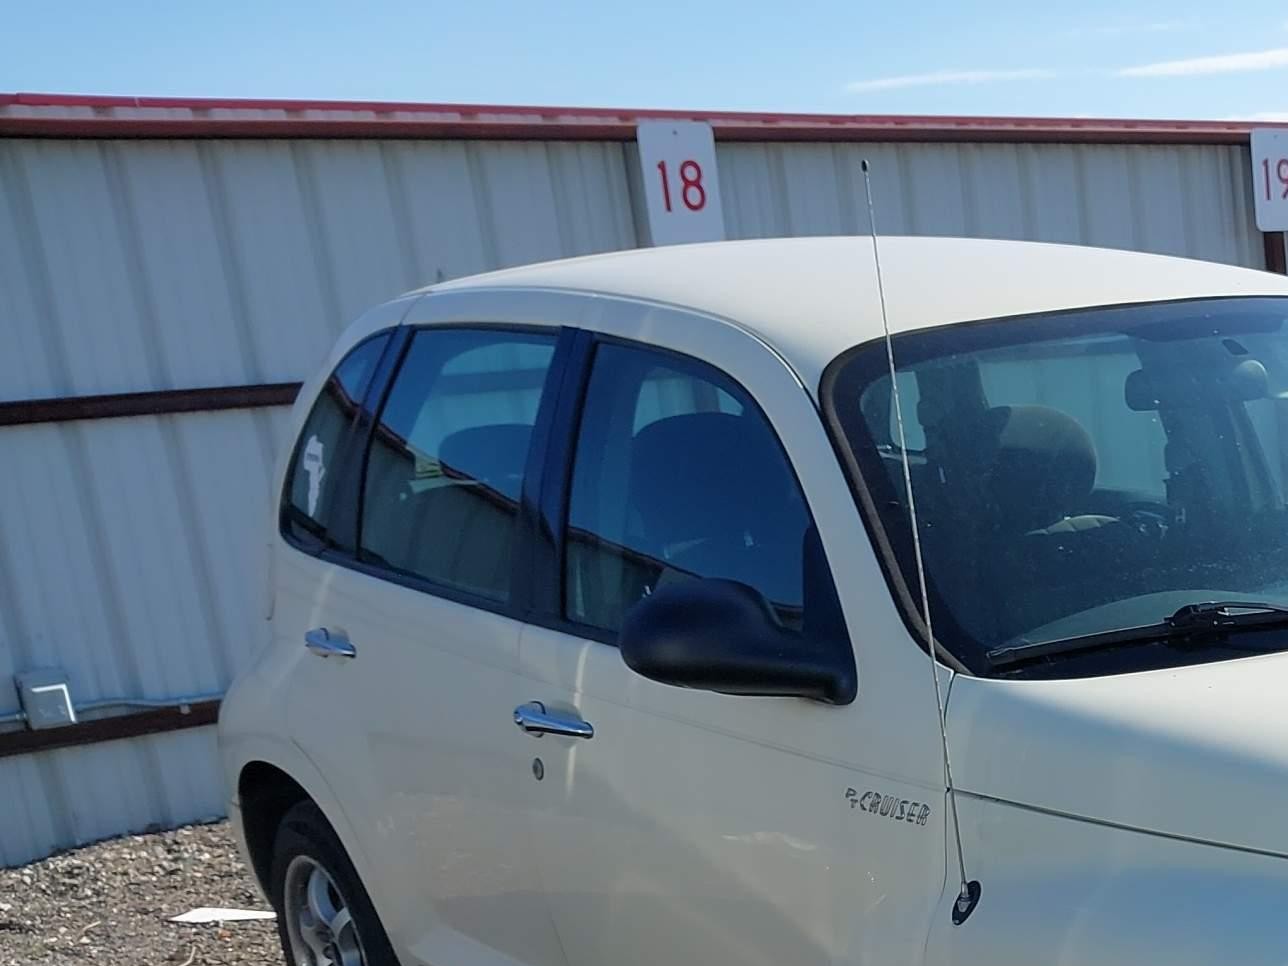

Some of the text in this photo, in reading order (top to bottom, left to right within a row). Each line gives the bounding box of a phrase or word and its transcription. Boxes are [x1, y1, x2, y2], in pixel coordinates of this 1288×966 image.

[657, 160, 706, 213] 18
[844, 787, 931, 826] PT CRUISER
